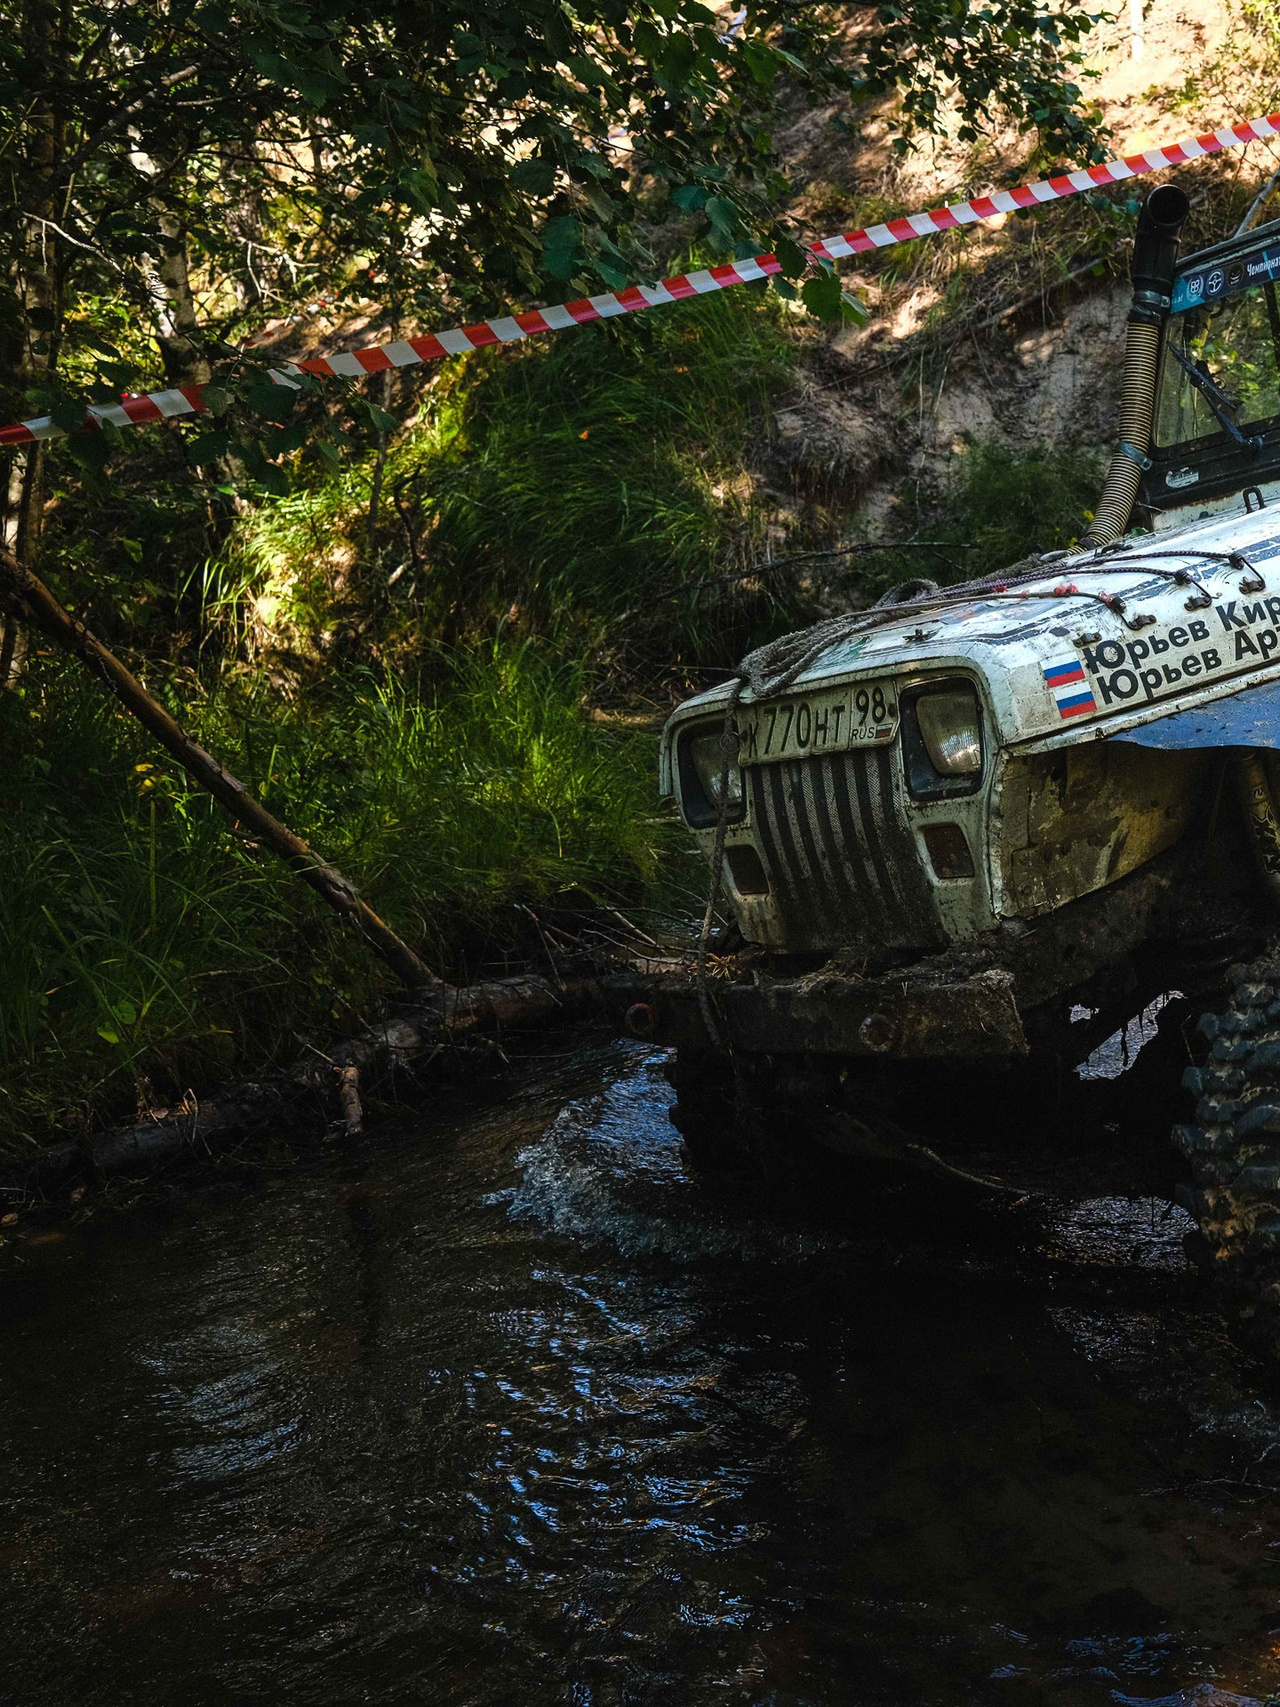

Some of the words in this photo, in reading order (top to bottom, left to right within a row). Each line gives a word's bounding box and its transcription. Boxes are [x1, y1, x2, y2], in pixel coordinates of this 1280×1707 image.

[1083, 620, 1210, 674] Юрьев
[1097, 648, 1222, 704] Юрьев
[855, 687, 887, 726] 98
[852, 727, 875, 740] RUS
